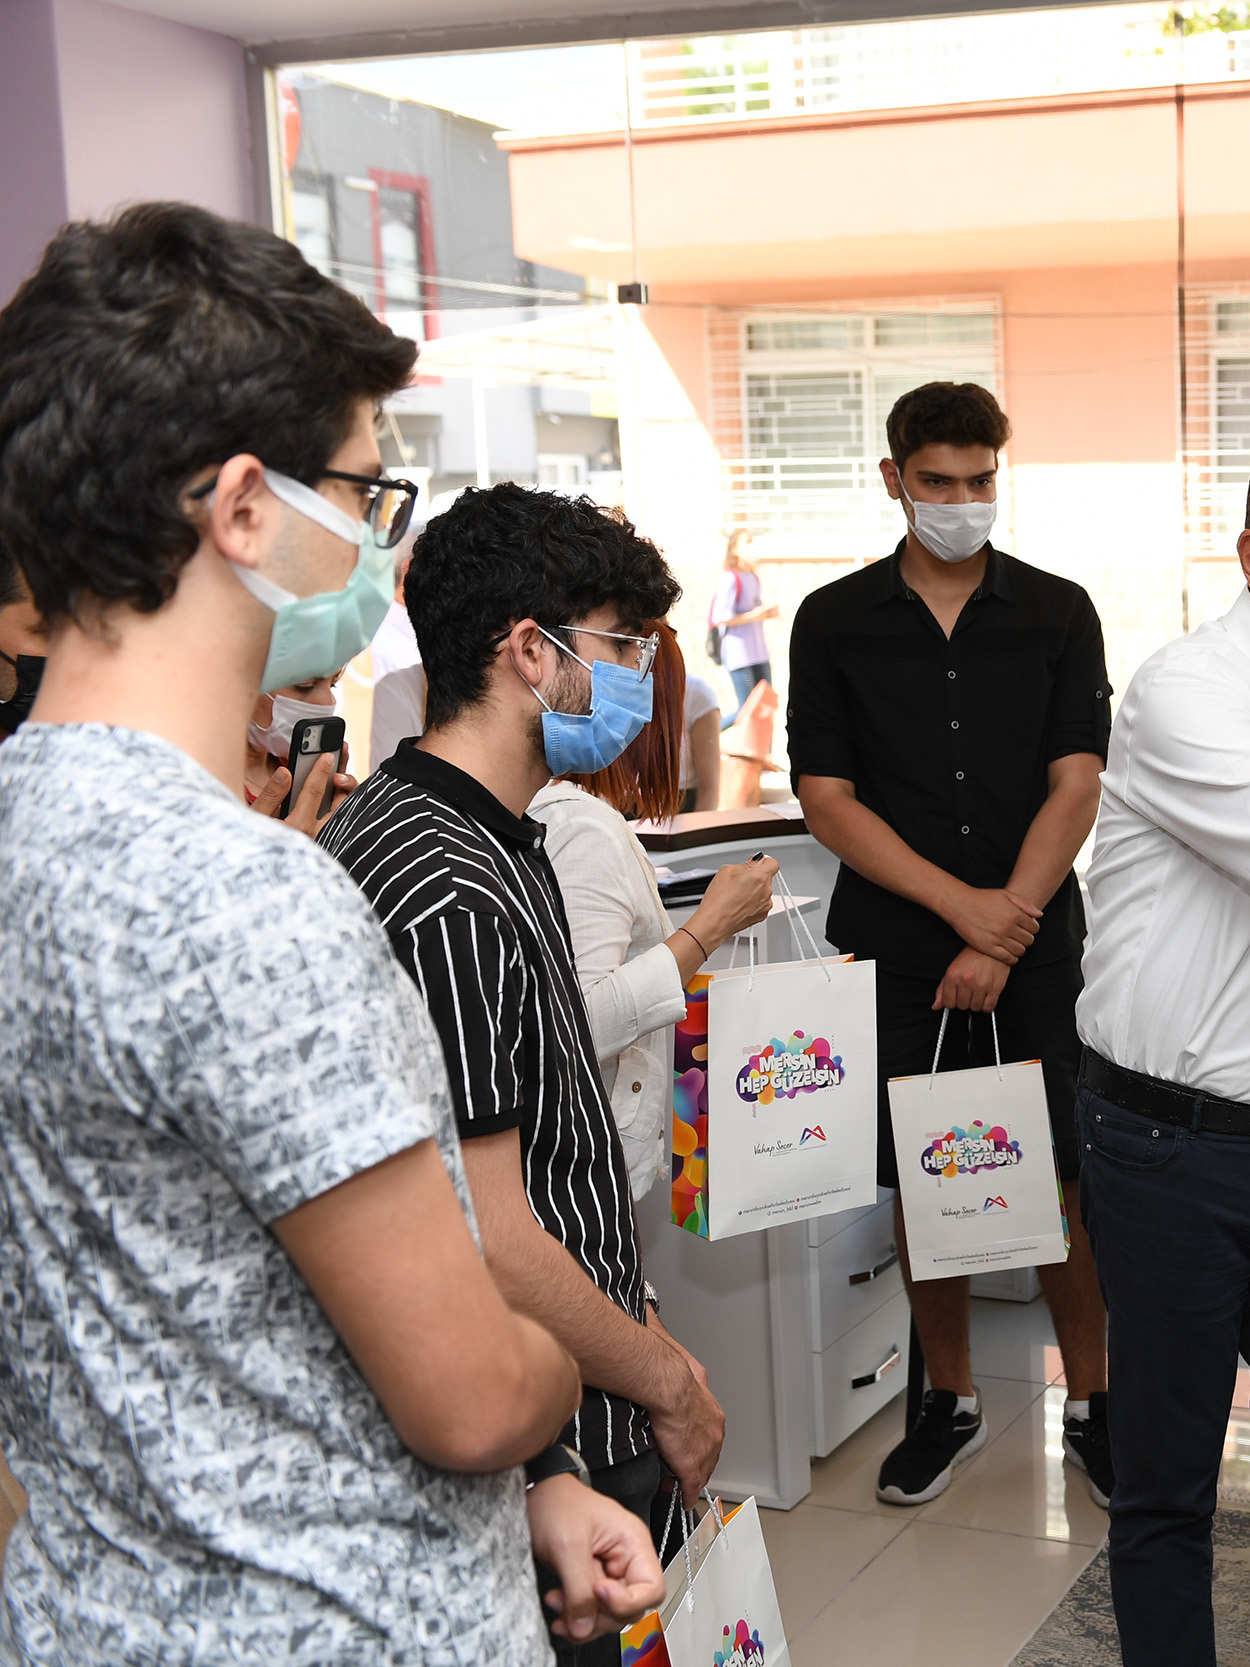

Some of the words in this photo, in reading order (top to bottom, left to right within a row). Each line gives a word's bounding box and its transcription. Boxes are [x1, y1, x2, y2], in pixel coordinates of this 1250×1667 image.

[759, 1048, 816, 1073] MERSİN
[739, 1074, 770, 1094] HEP
[770, 1064, 841, 1092] GÜZELSİN
[941, 1134, 996, 1153] MERSİN
[923, 1154, 952, 1170] HEP
[953, 1147, 1018, 1169] GÜZELSİN
